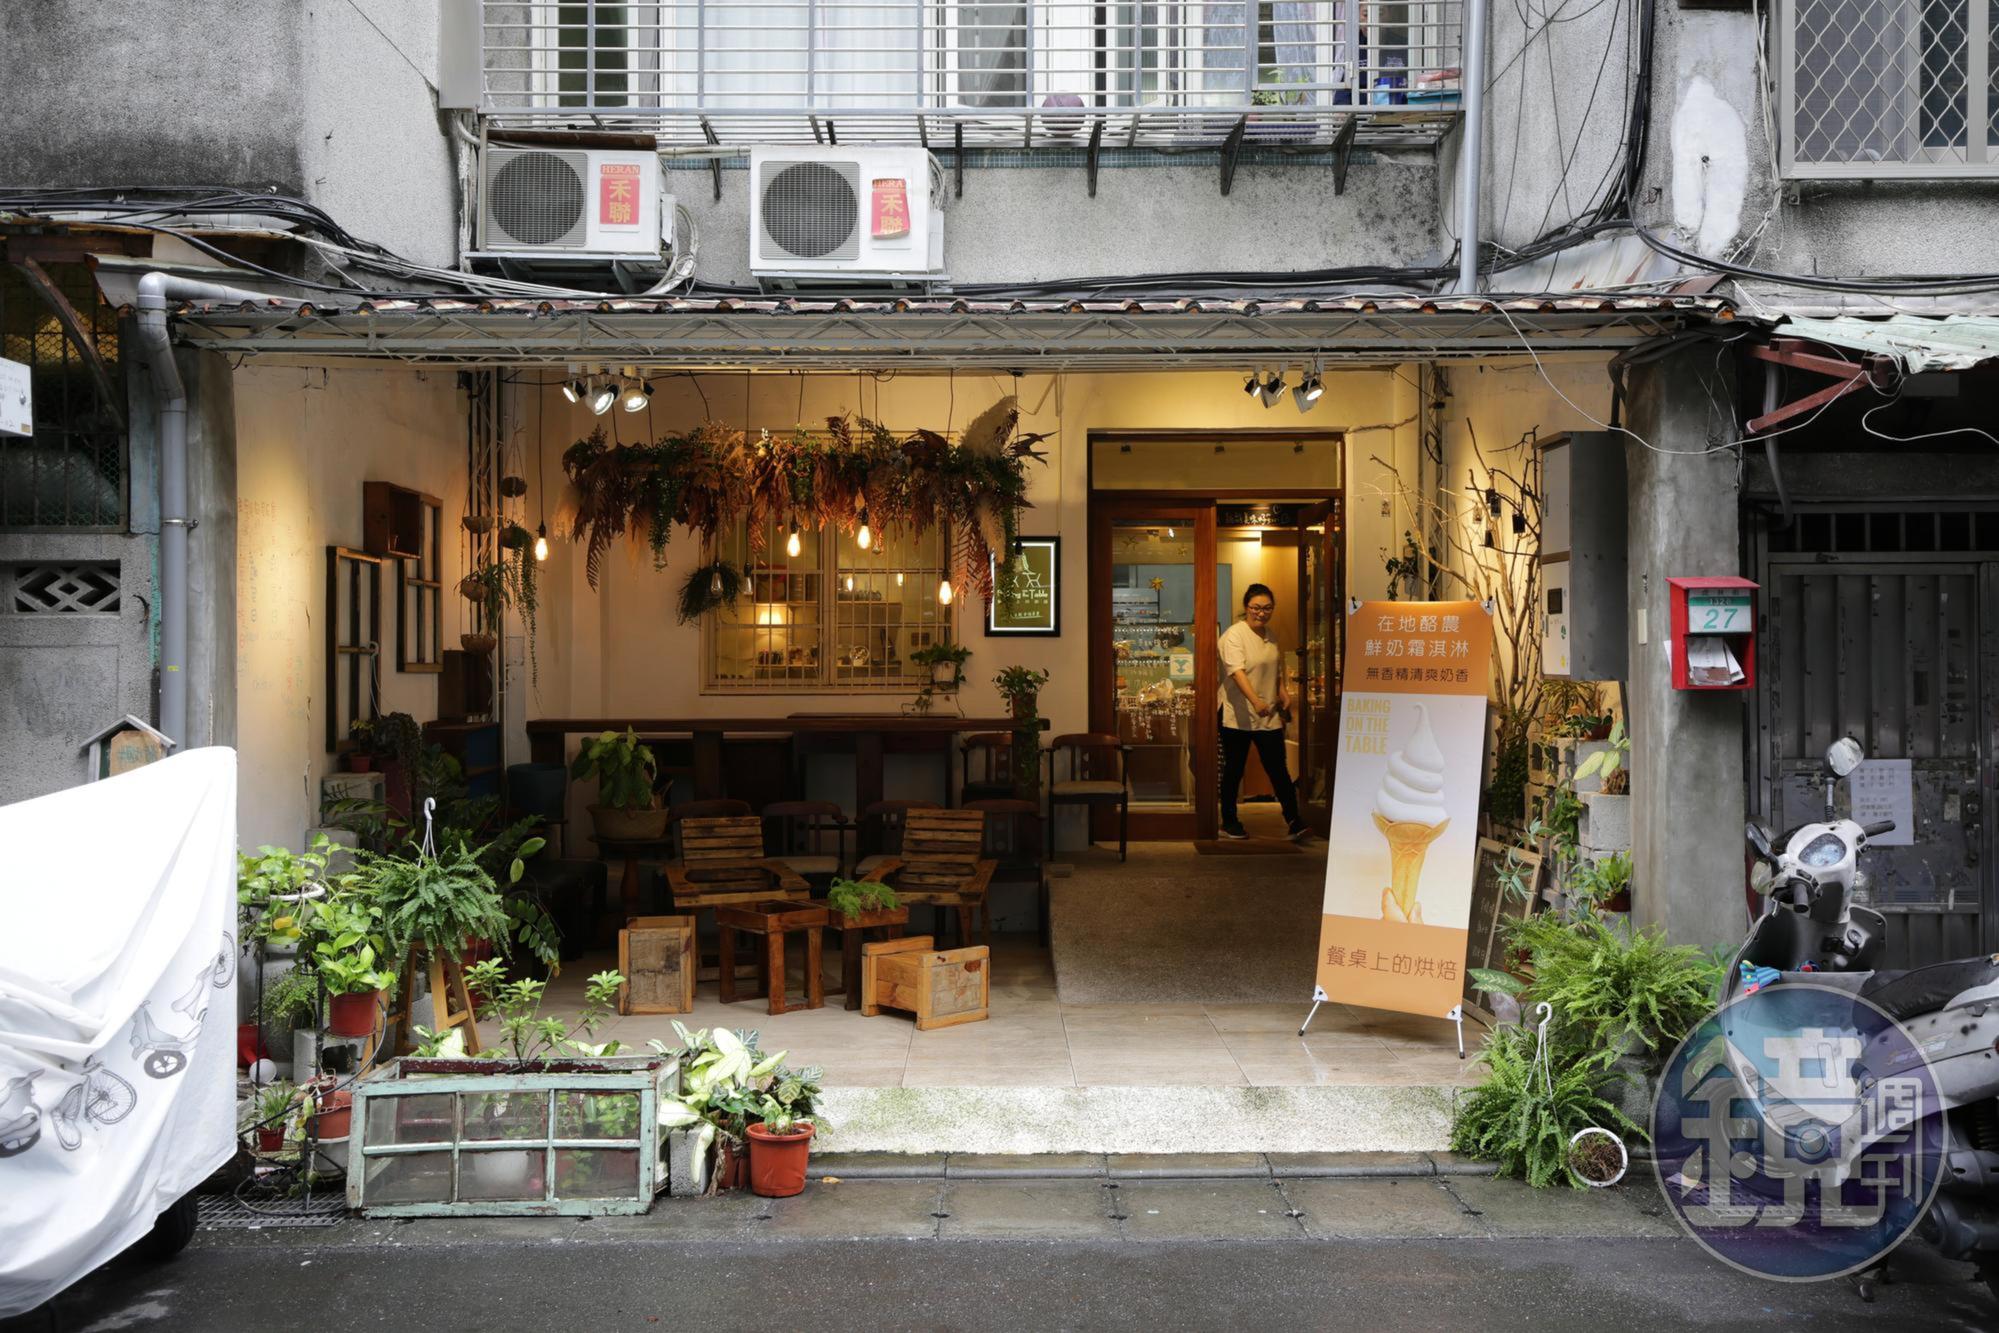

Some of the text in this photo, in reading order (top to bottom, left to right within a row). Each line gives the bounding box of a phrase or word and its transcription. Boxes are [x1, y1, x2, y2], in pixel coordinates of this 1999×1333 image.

[602, 165, 640, 175] HERAN
[874, 180, 905, 189] HERA
[609, 180, 631, 224] 禾聯
[1377, 615, 1460, 634] 在地酪農
[1704, 608, 1738, 629] 27
[1364, 639, 1469, 659] 鮮奶霜淇淋
[1366, 665, 1469, 683] 無香精清爽奶香
[1347, 697, 1392, 714] BAKING
[1346, 716, 1390, 734] ON THE
[1345, 735, 1388, 755] TABLE
[1326, 945, 1458, 981] 餐桌上的烘焙
